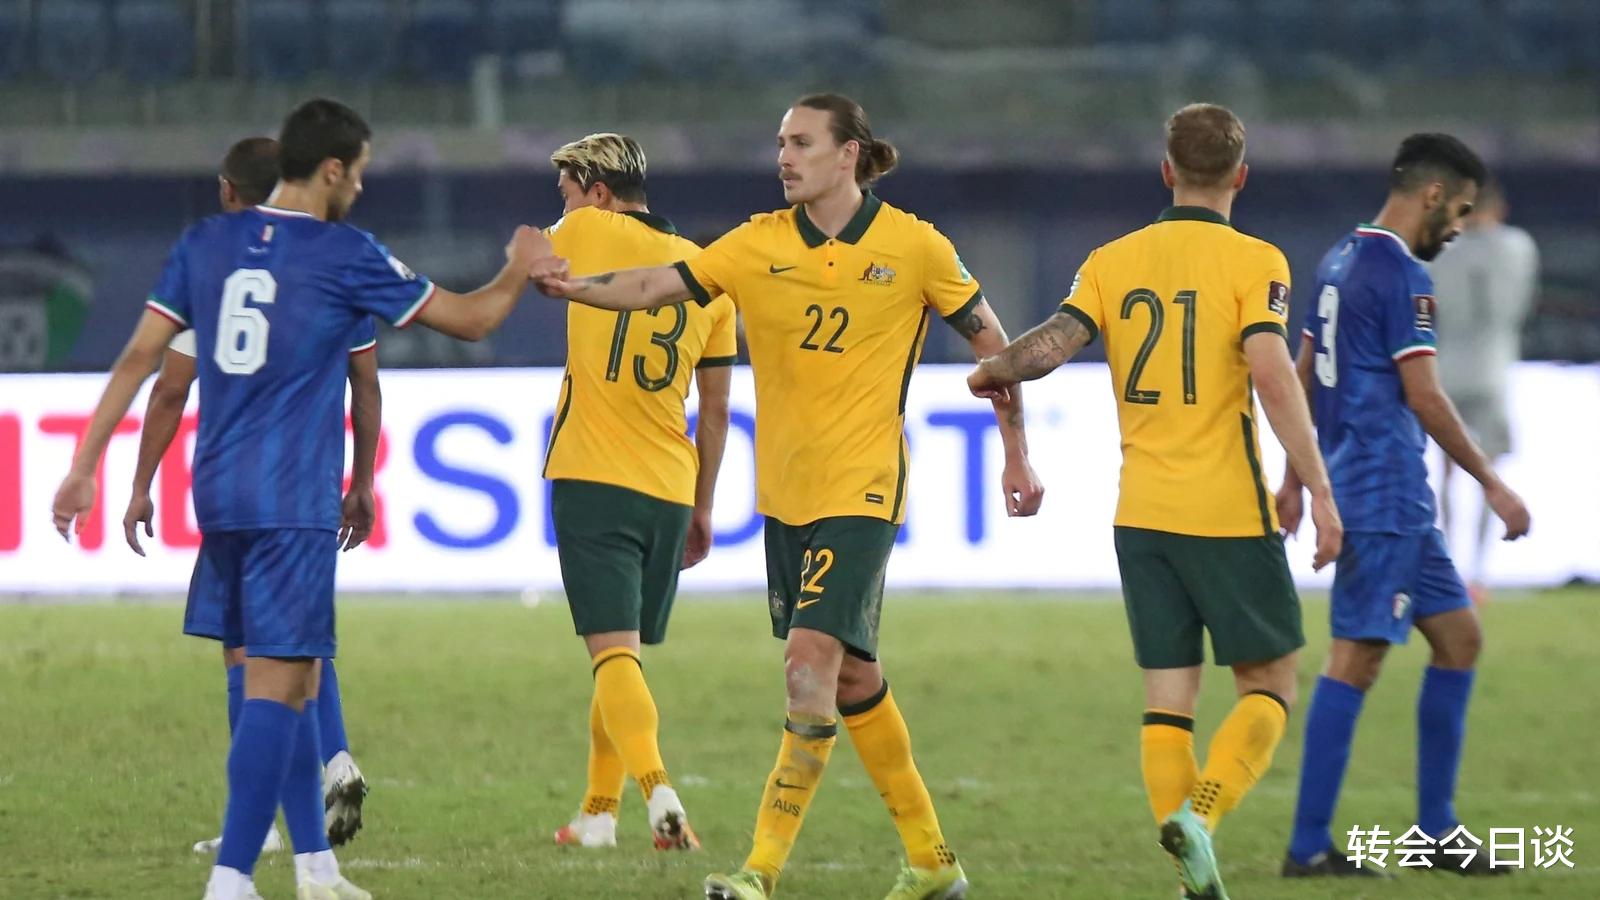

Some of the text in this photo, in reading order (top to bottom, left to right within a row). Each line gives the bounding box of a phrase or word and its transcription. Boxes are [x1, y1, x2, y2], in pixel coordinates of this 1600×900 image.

[213, 268, 277, 374] 6
[606, 300, 687, 392] 13
[800, 304, 849, 353] 22
[1120, 288, 1197, 405] 21
[1315, 284, 1339, 388] 3
[773, 798, 801, 817] AUS
